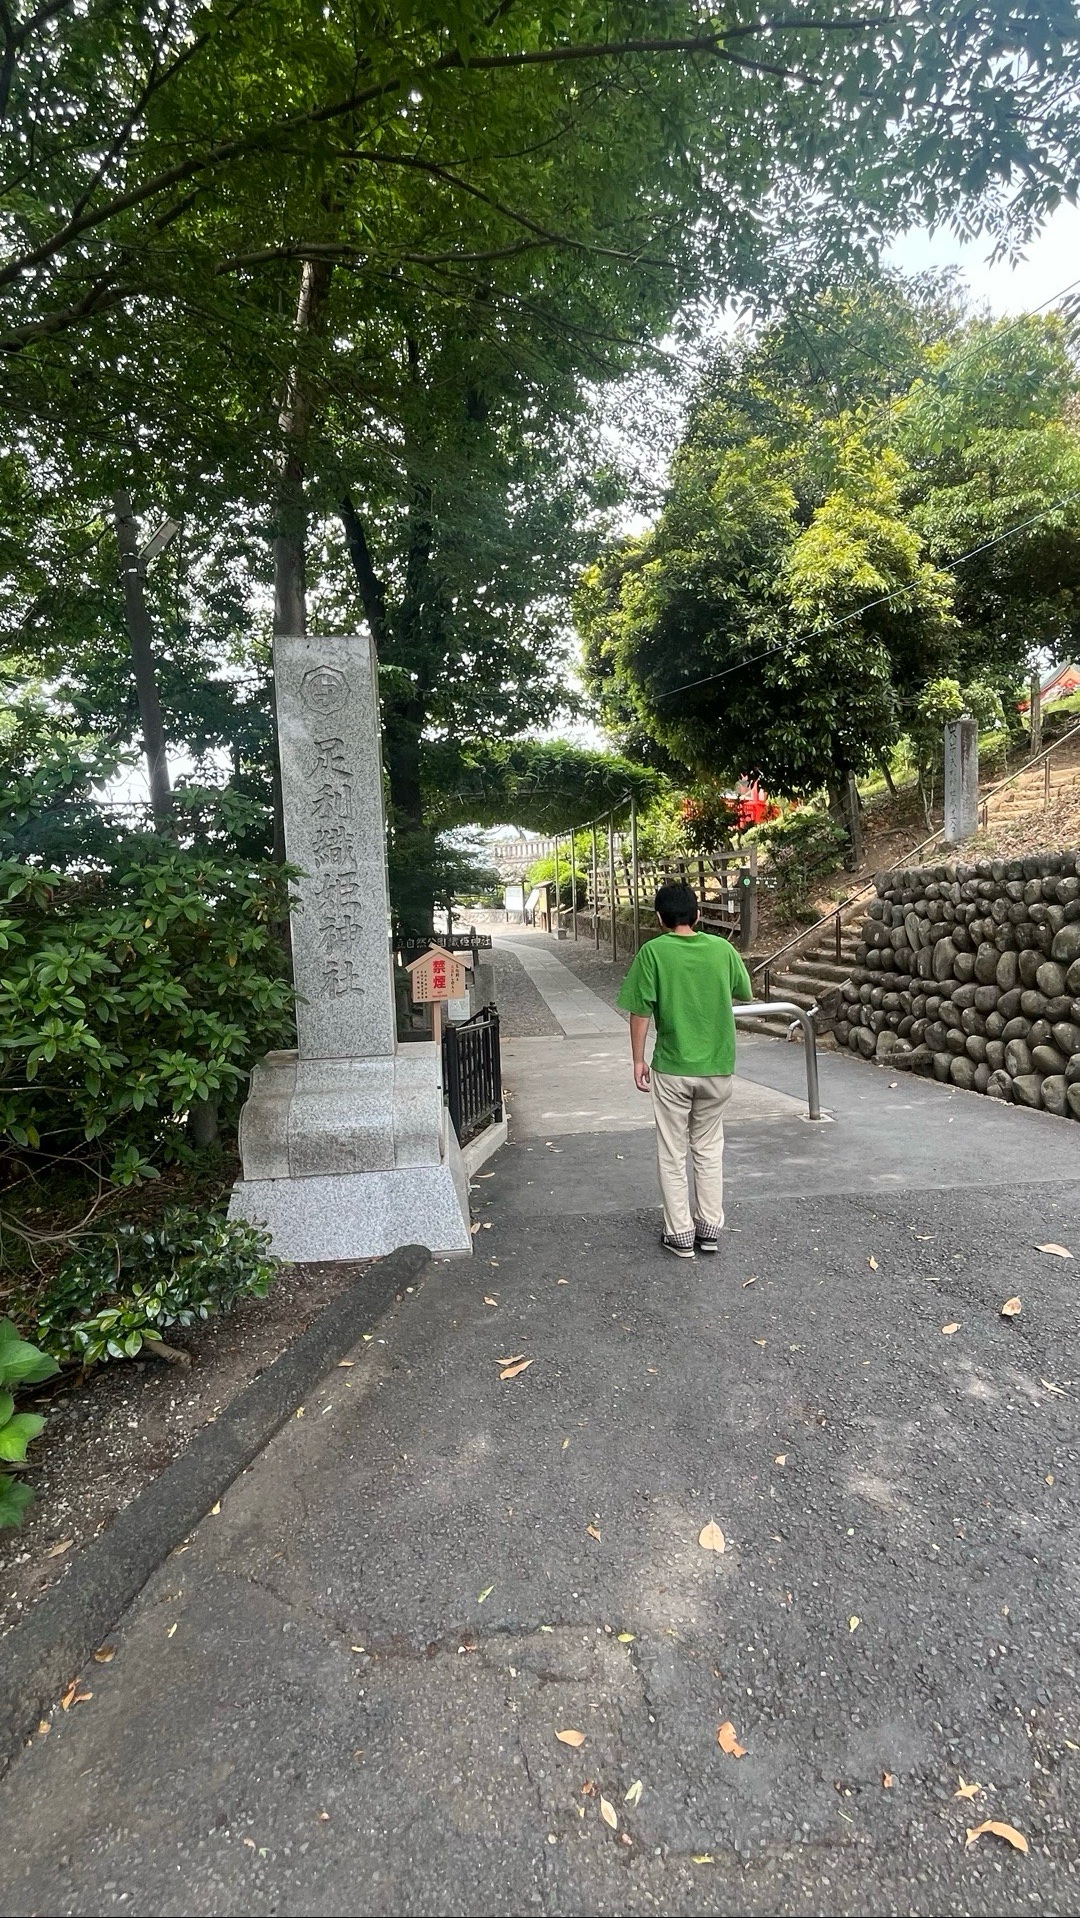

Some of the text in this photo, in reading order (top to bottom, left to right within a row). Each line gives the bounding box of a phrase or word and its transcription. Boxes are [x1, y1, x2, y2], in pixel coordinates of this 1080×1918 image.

[307, 738, 364, 1000] 足利織姫神社
[433, 960, 446, 989] 禁煙
